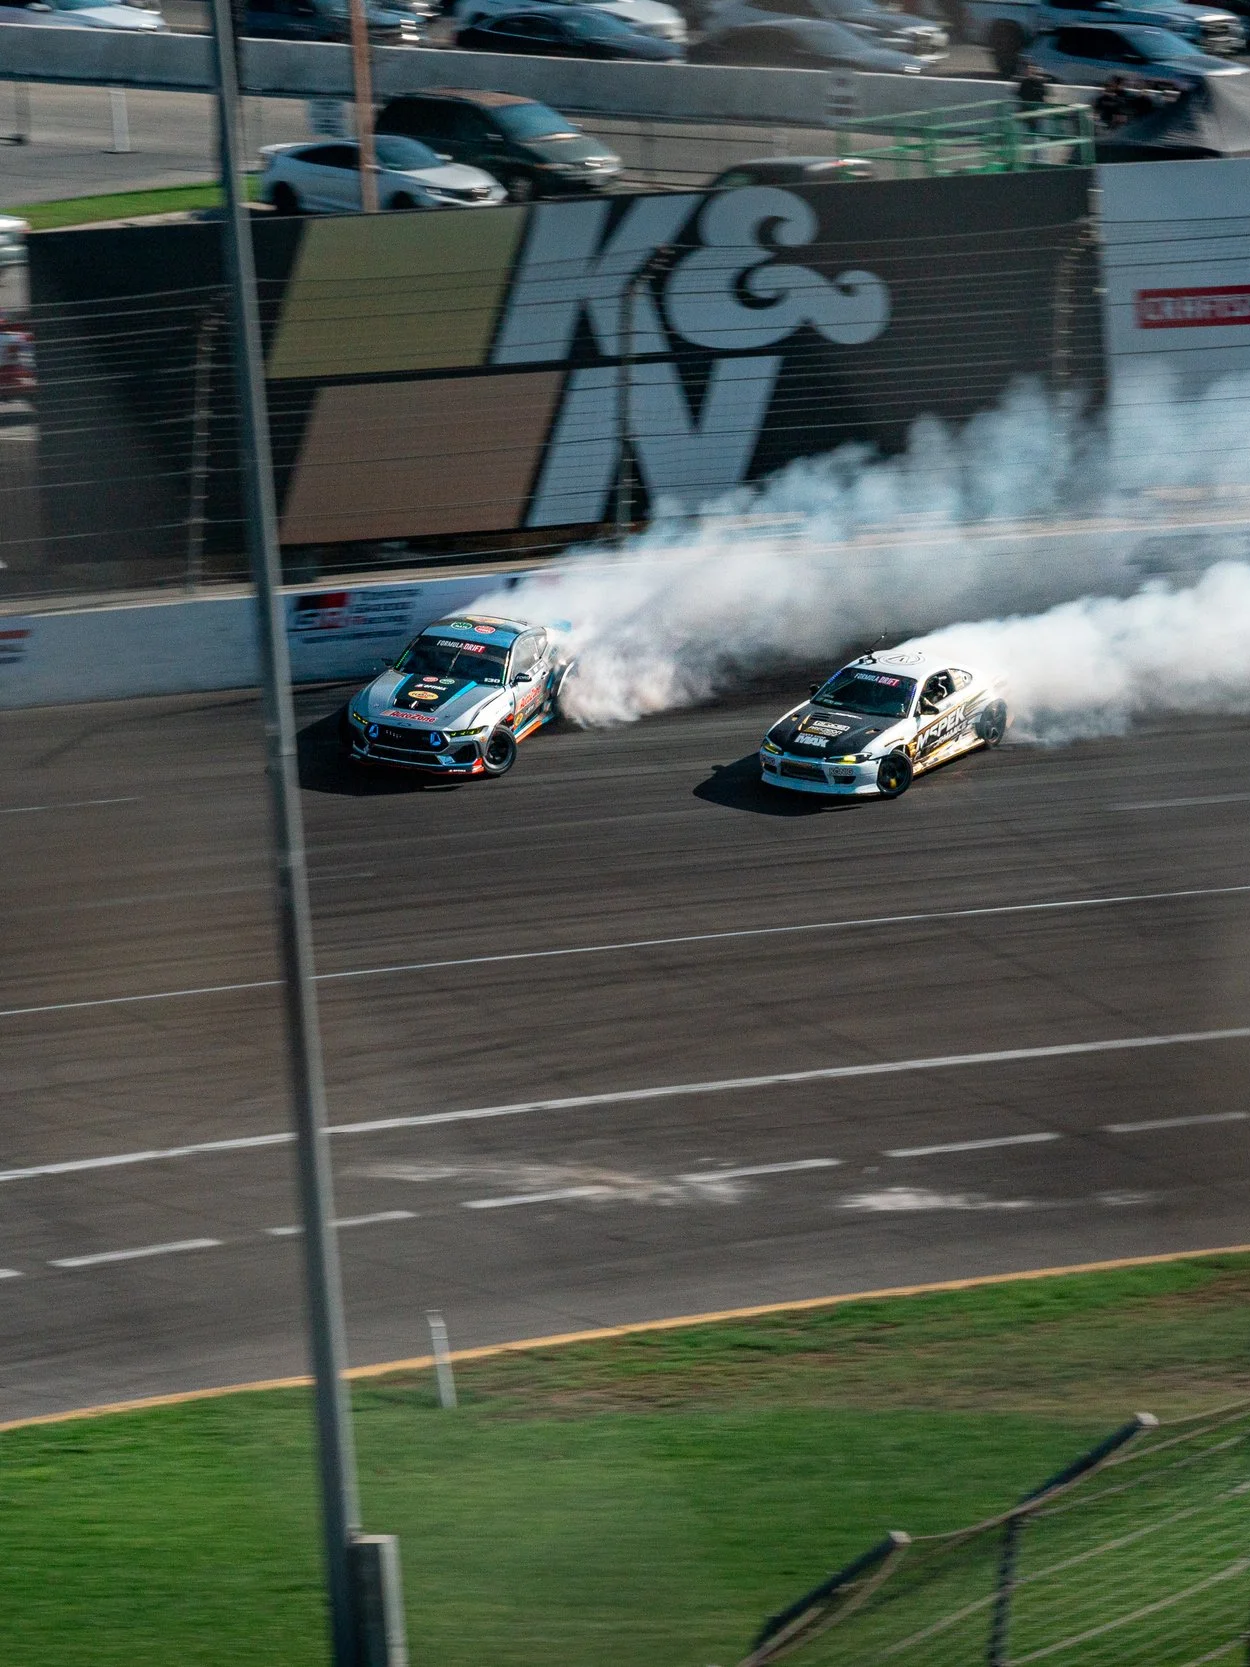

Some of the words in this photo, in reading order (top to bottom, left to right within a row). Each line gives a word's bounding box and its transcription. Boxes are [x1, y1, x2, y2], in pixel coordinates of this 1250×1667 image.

[436, 639, 464, 649] FORMULA
[463, 642, 486, 653] DRIFT
[854, 672, 880, 684] FORMULA
[878, 676, 900, 687] DRIFT
[390, 710, 437, 723] AutoZone
